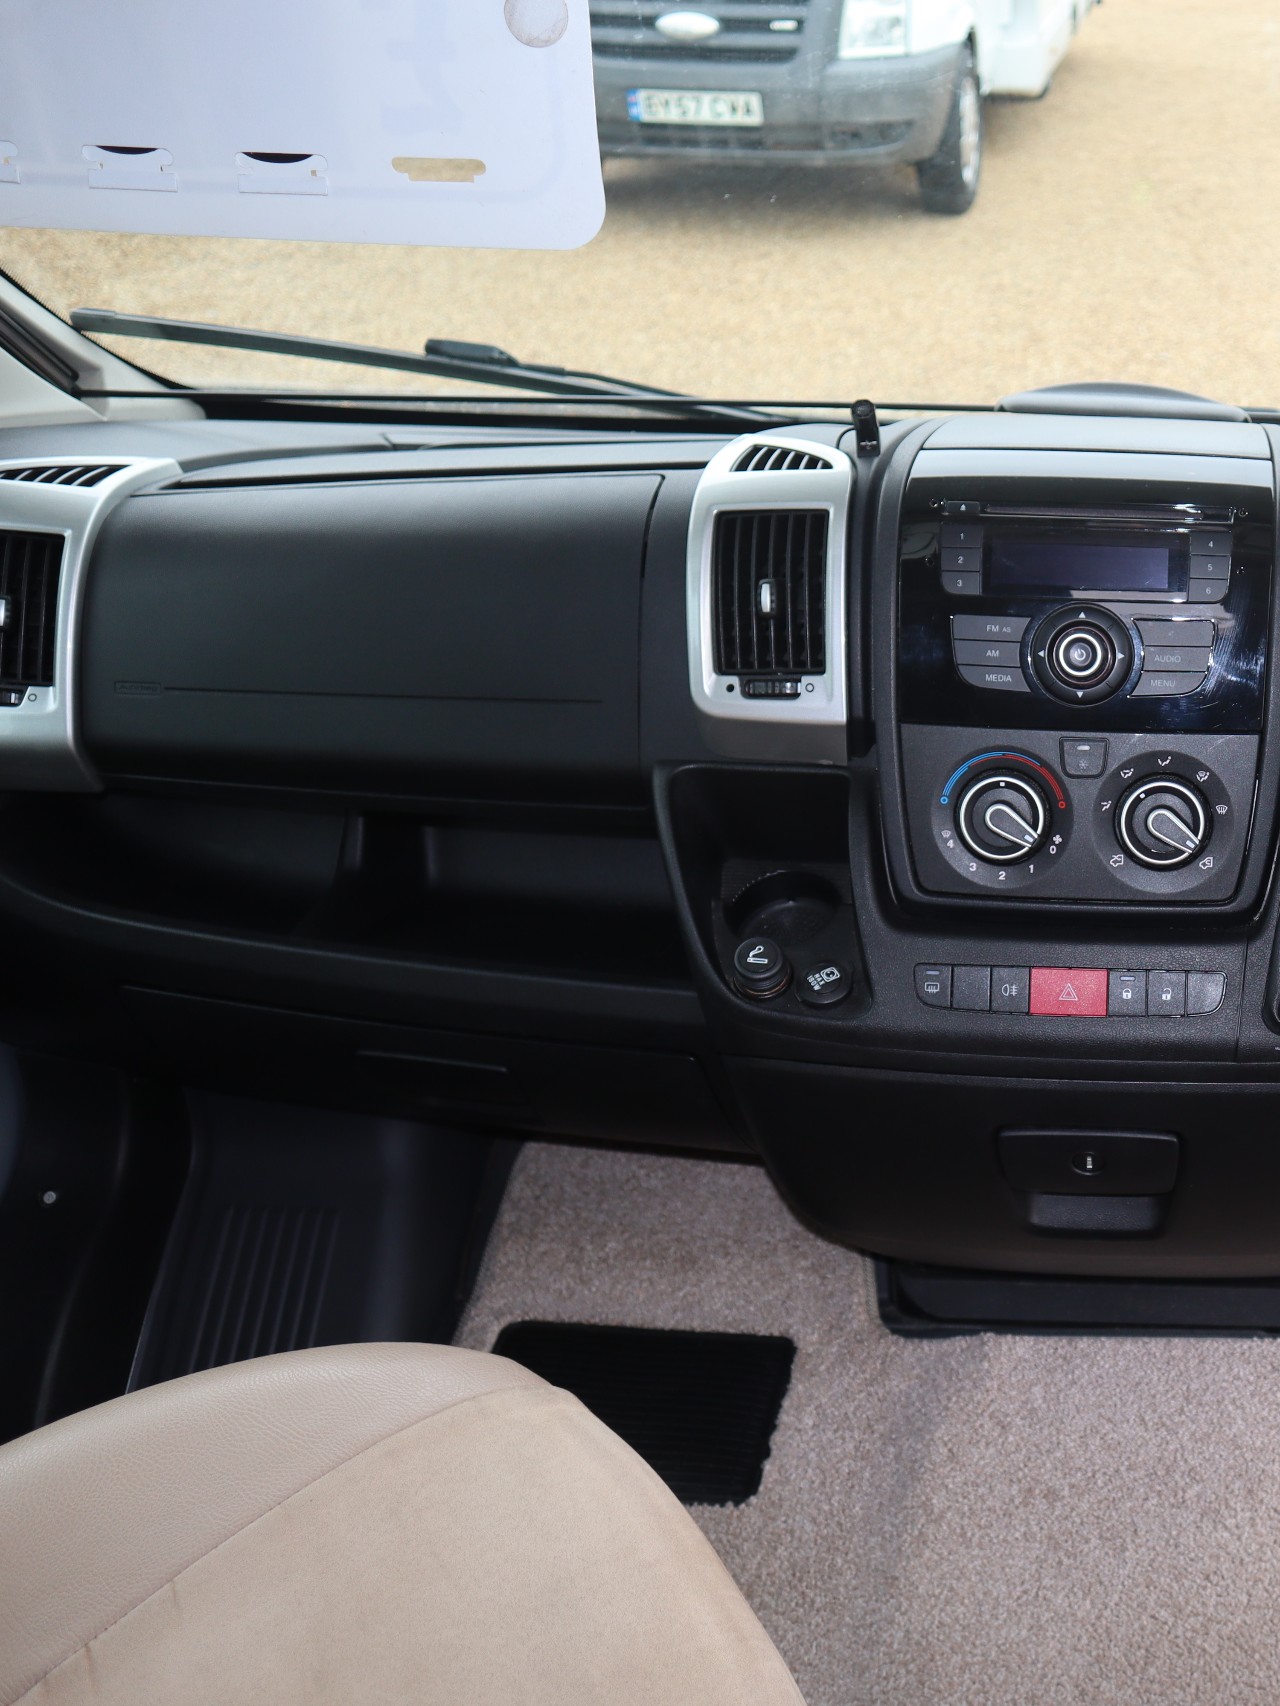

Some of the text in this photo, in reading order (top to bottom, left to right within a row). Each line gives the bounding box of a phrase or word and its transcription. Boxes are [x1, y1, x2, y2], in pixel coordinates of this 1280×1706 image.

[958, 556, 964, 564] 2
[986, 624, 998, 632] FM
[1154, 654, 1182, 662] AUDIO
[986, 674, 1012, 682] MEDIA
[947, 839, 954, 848] 4
[1050, 846, 1056, 854] 0
[969, 862, 976, 872] 3
[1028, 864, 1034, 873] 1
[998, 871, 1006, 880] 2
